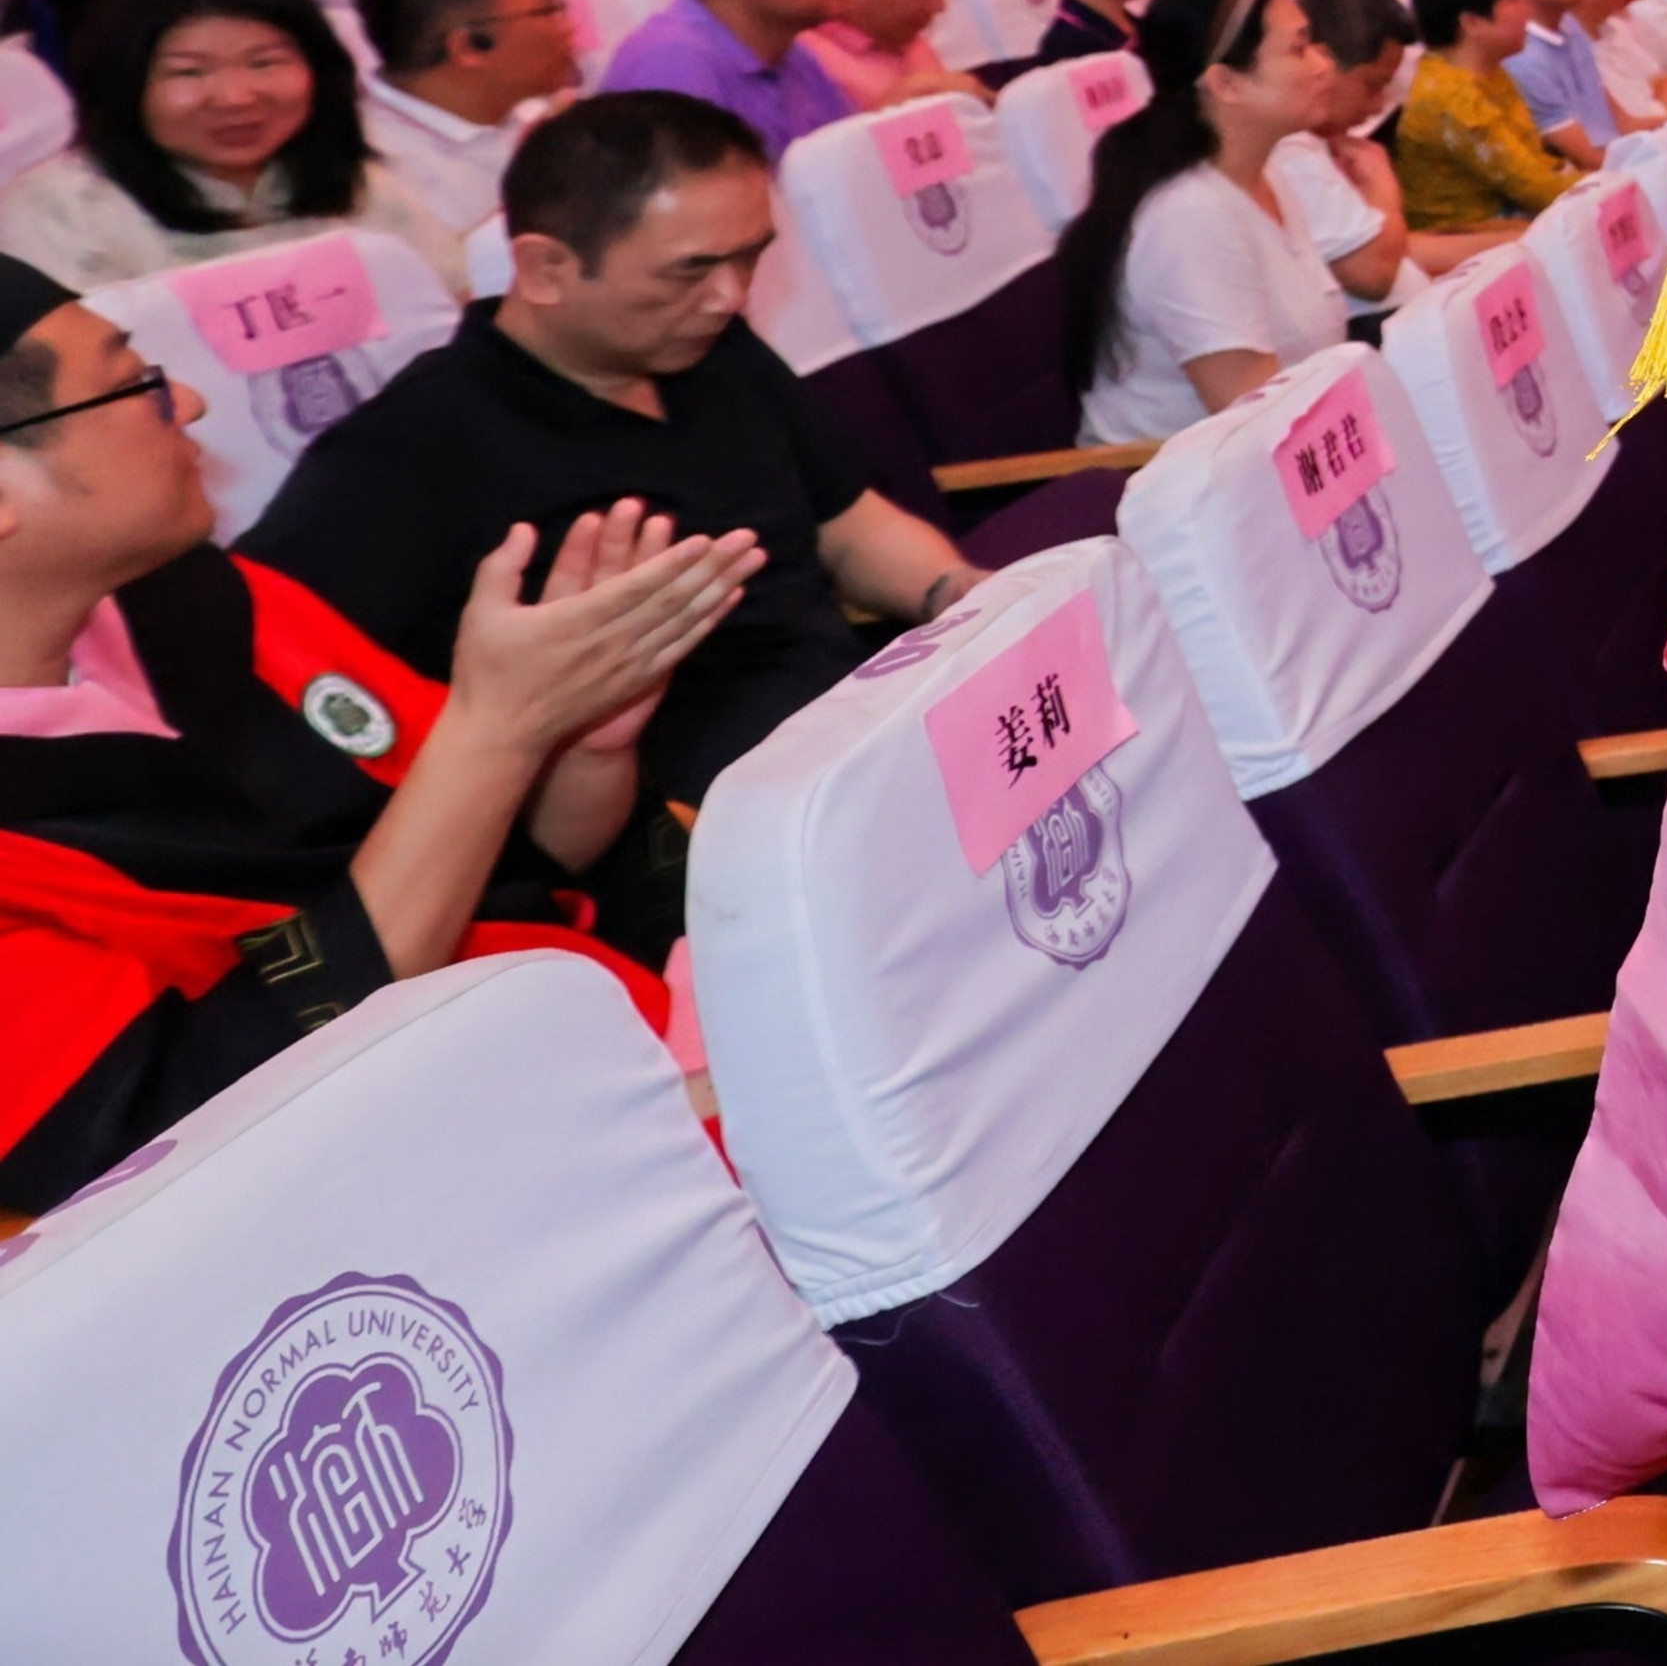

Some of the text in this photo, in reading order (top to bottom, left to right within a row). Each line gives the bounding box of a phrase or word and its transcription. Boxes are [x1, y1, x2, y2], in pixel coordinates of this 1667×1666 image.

[994, 673, 1072, 789] 姜莉
[203, 1309, 480, 1634] HAINAN NORMAL UNIVERSITY
